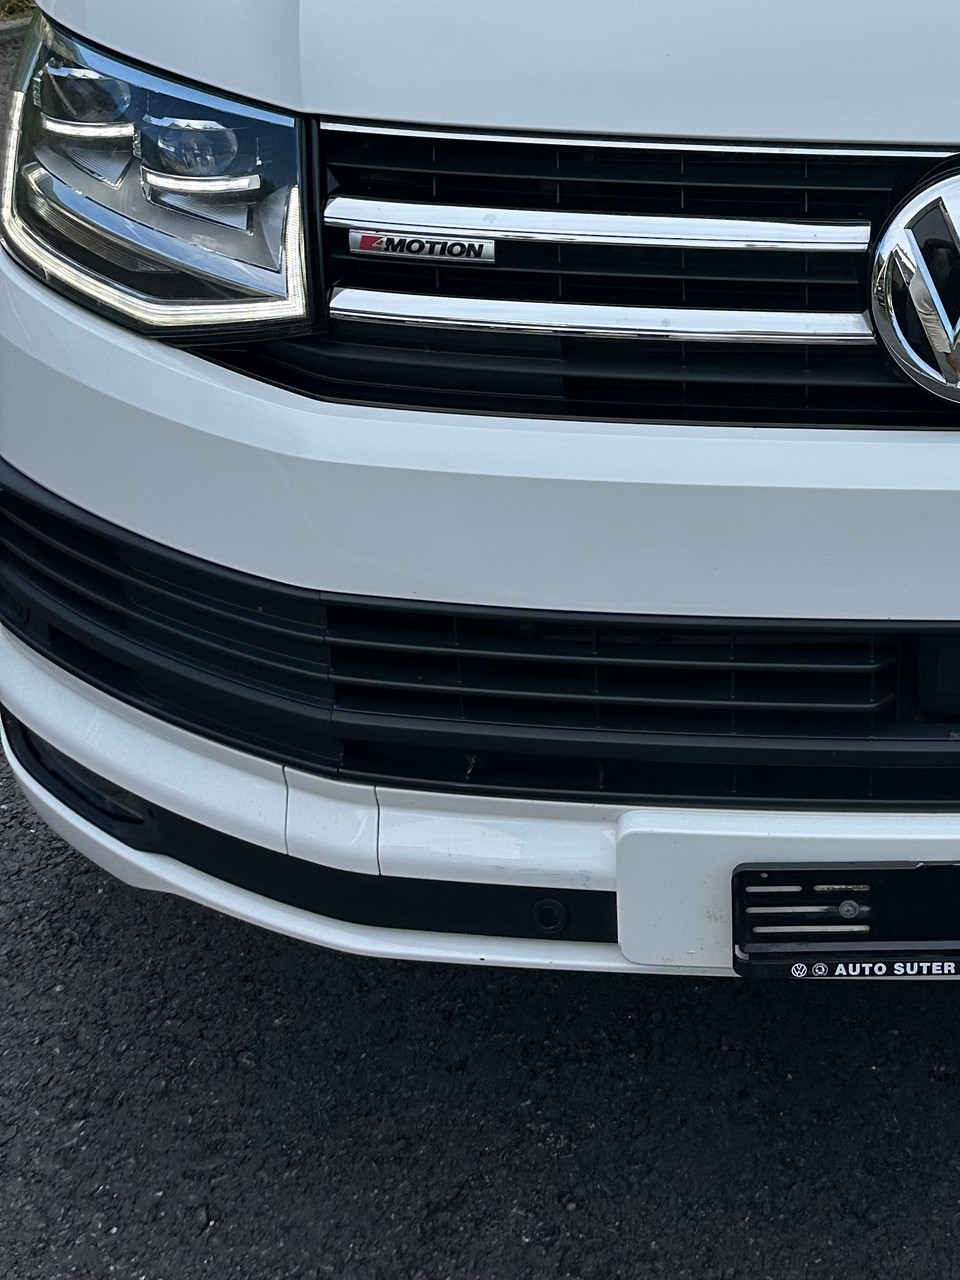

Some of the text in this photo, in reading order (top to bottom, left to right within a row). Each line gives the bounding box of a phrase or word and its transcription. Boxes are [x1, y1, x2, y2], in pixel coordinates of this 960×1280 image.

[371, 234, 485, 258] 4MOTION
[834, 962, 887, 976] AUTO
[893, 962, 956, 975] SUTER
